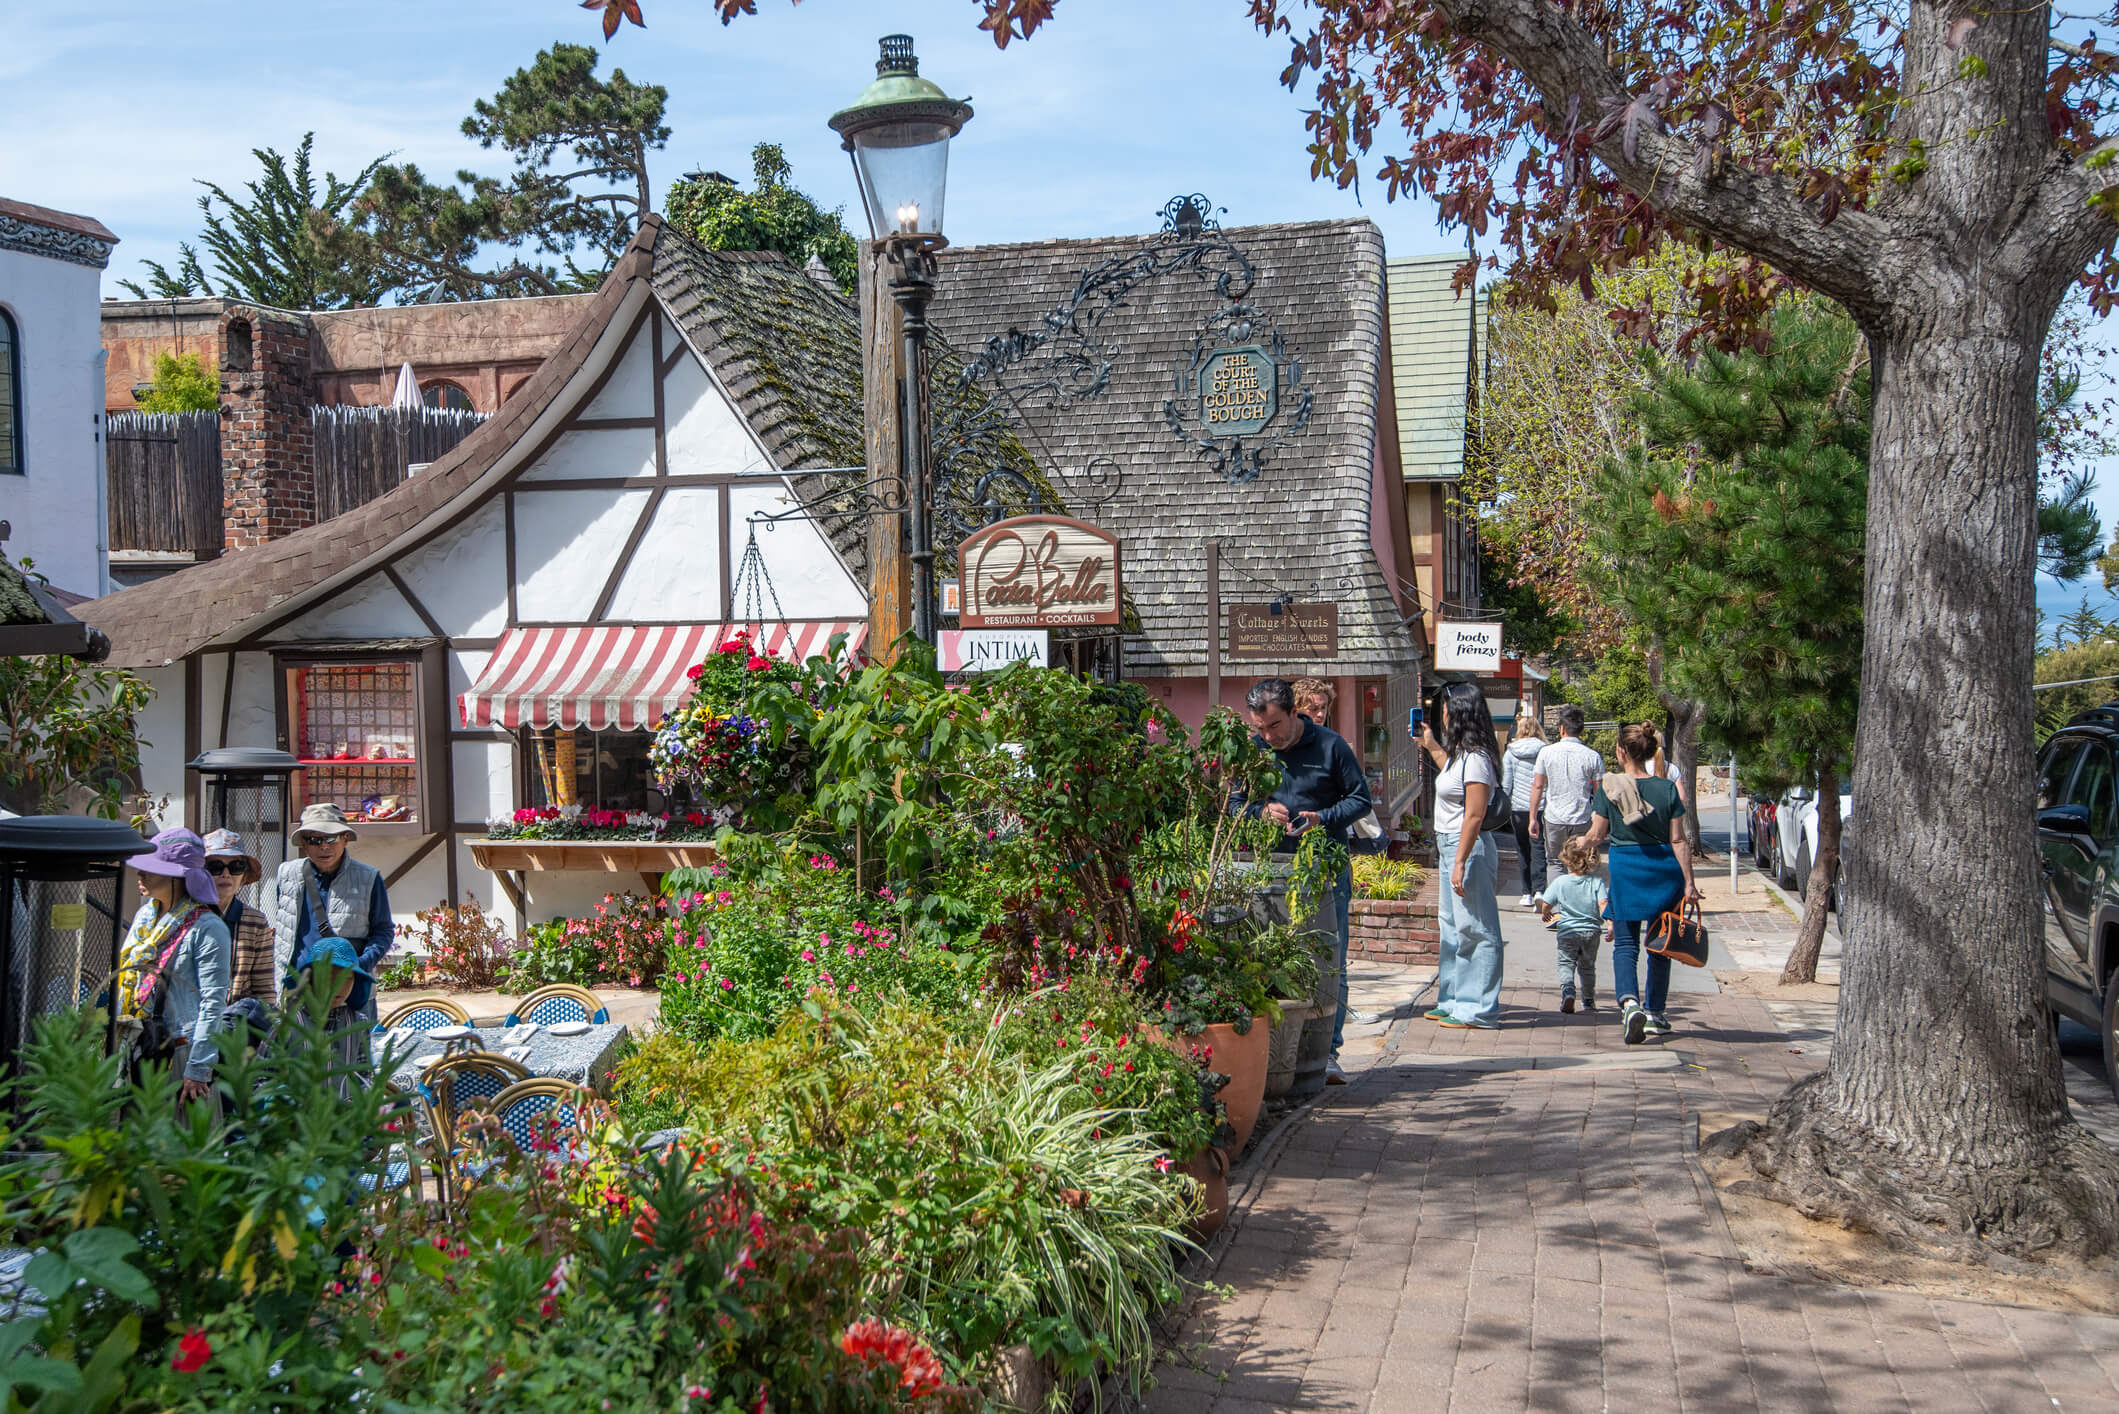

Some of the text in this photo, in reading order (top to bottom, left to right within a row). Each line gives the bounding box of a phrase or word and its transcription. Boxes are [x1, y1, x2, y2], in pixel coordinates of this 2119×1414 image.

[1224, 354, 1248, 367] THE
[1214, 366, 1257, 380] COURT
[1213, 378, 1258, 392] OF THE
[1205, 389, 1268, 408] GOLDEN
[1208, 406, 1266, 422] BOUGH
[984, 614, 1096, 625] RESTAURANT COCKTAILS
[1238, 613, 1280, 631] Cottage
[1239, 634, 1269, 643] IMPORTED
[1273, 634, 1298, 642] ENGLISH
[1456, 631, 1490, 645] body
[970, 641, 1041, 660] INTIMA
[1262, 643, 1306, 652] CHOCOLATES
[1456, 644, 1497, 657] frenzy
